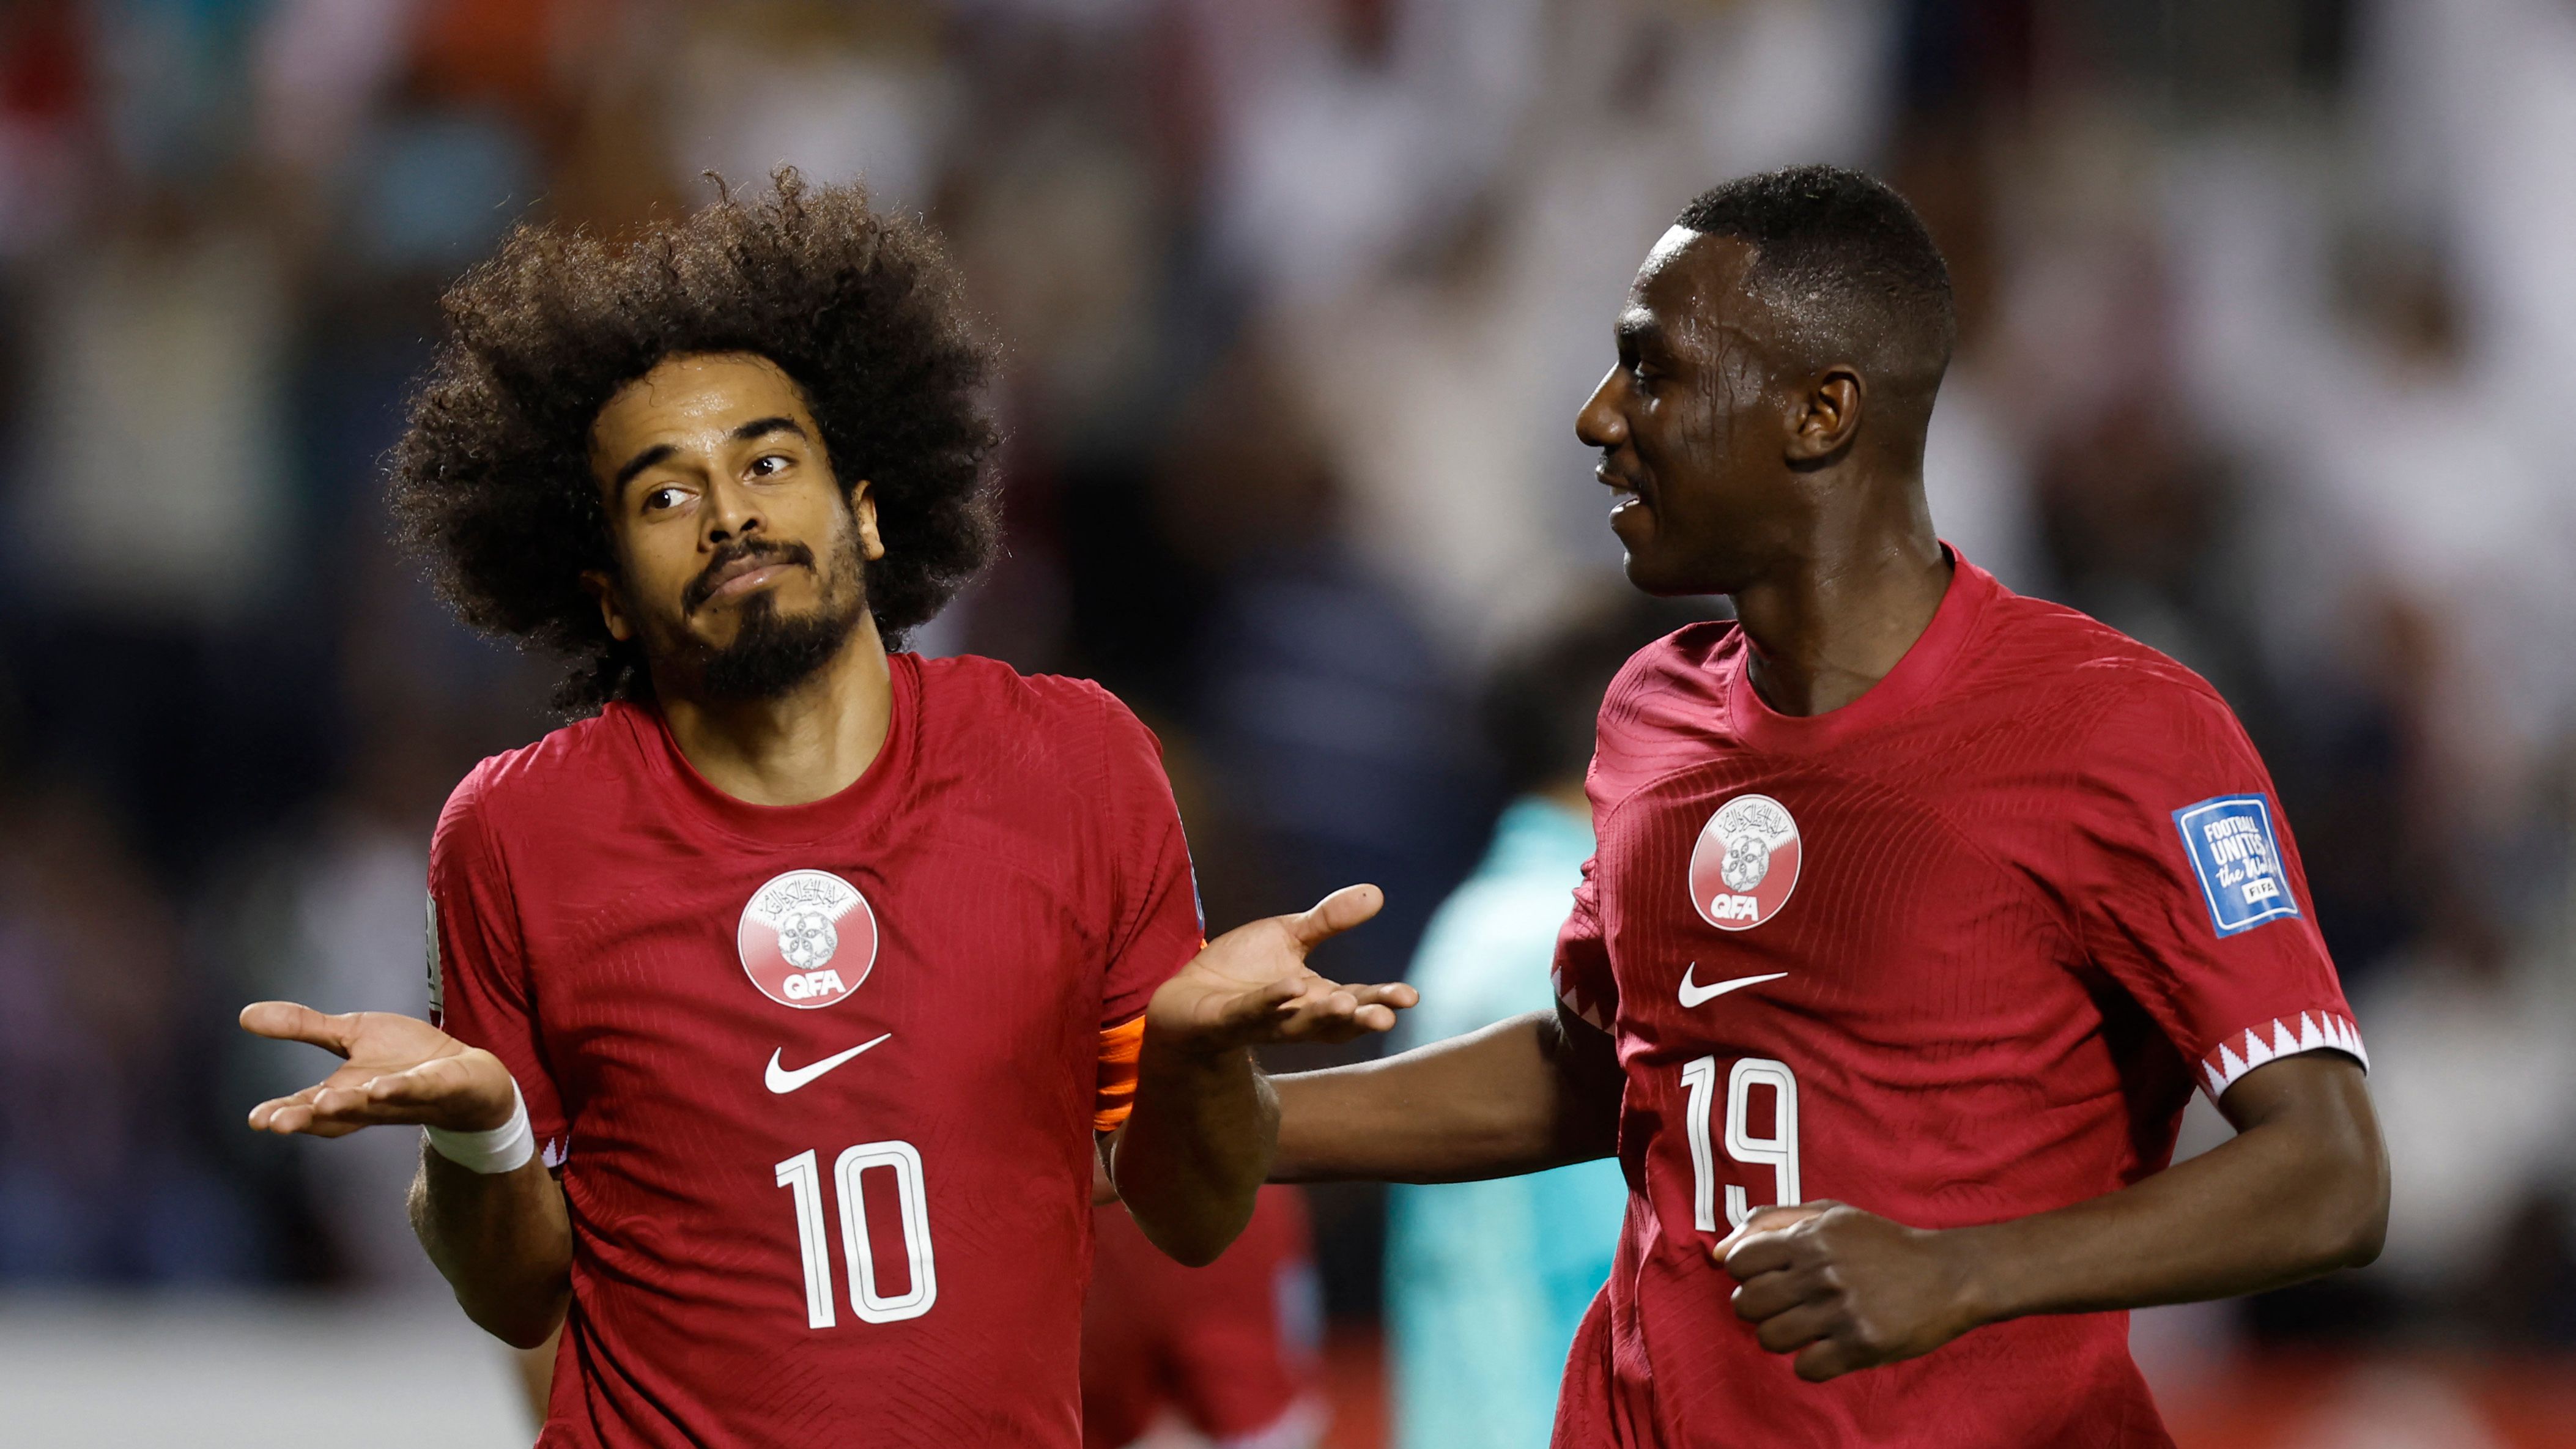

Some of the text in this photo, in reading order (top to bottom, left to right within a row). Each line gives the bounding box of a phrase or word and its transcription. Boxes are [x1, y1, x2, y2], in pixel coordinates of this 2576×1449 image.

[2204, 816, 2259, 843] FOOTBALL
[2215, 864, 2245, 888] the
[2249, 883, 2274, 897] FIFA
[1711, 894, 1759, 921] QFA
[783, 969, 846, 999] QFA
[1680, 1054, 1801, 1232] 19
[775, 1140, 938, 1329] 10
